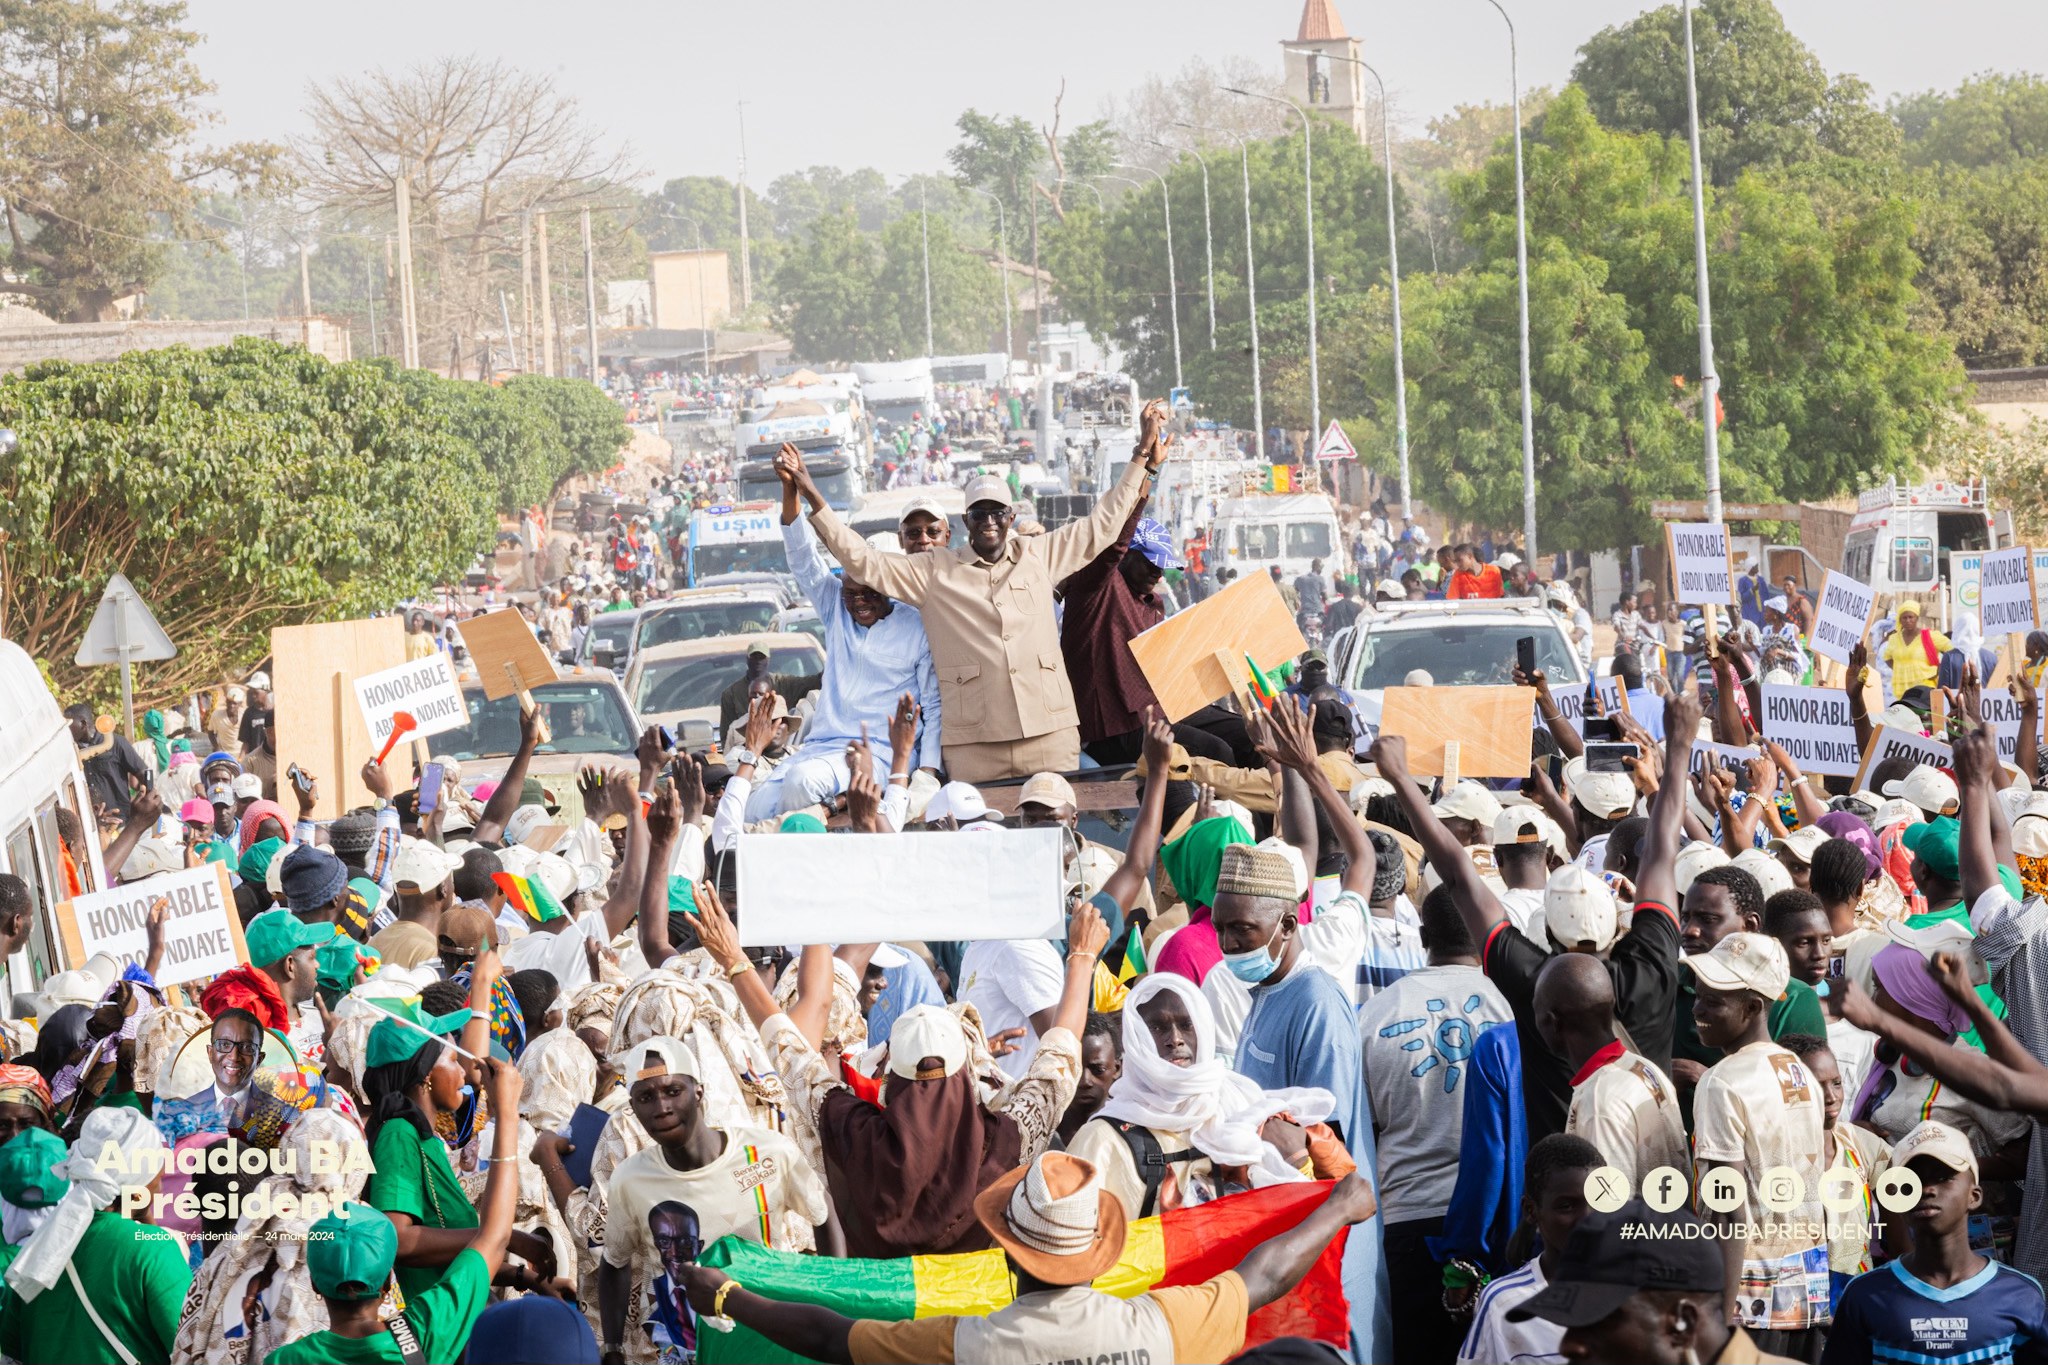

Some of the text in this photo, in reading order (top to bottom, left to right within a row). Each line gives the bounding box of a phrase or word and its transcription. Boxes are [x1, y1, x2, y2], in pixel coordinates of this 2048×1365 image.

[713, 518, 771, 531] USM
[1676, 533, 1726, 557] HONORABLE
[1681, 571, 1730, 592] ABDOU NDIAYE
[1983, 556, 2029, 588] HONORABLE
[1825, 583, 1870, 622] HONORABLE
[1983, 599, 2034, 626] ABDOU NDIAYE
[1816, 620, 1860, 651] ABDOU NDIAY
[363, 663, 449, 709] HONORABLE
[415, 695, 460, 724] NDIAYE
[1814, 741, 1859, 764] NDIAYE
[165, 928, 230, 966] NDIAYE
[733, 1163, 760, 1178] Benno
[388, 1315, 418, 1355] BIMB
[1913, 1330, 1967, 1339] Matar Kalla
[1940, 1320, 1966, 1328] CEM
[1926, 1341, 1954, 1350] Dramé
